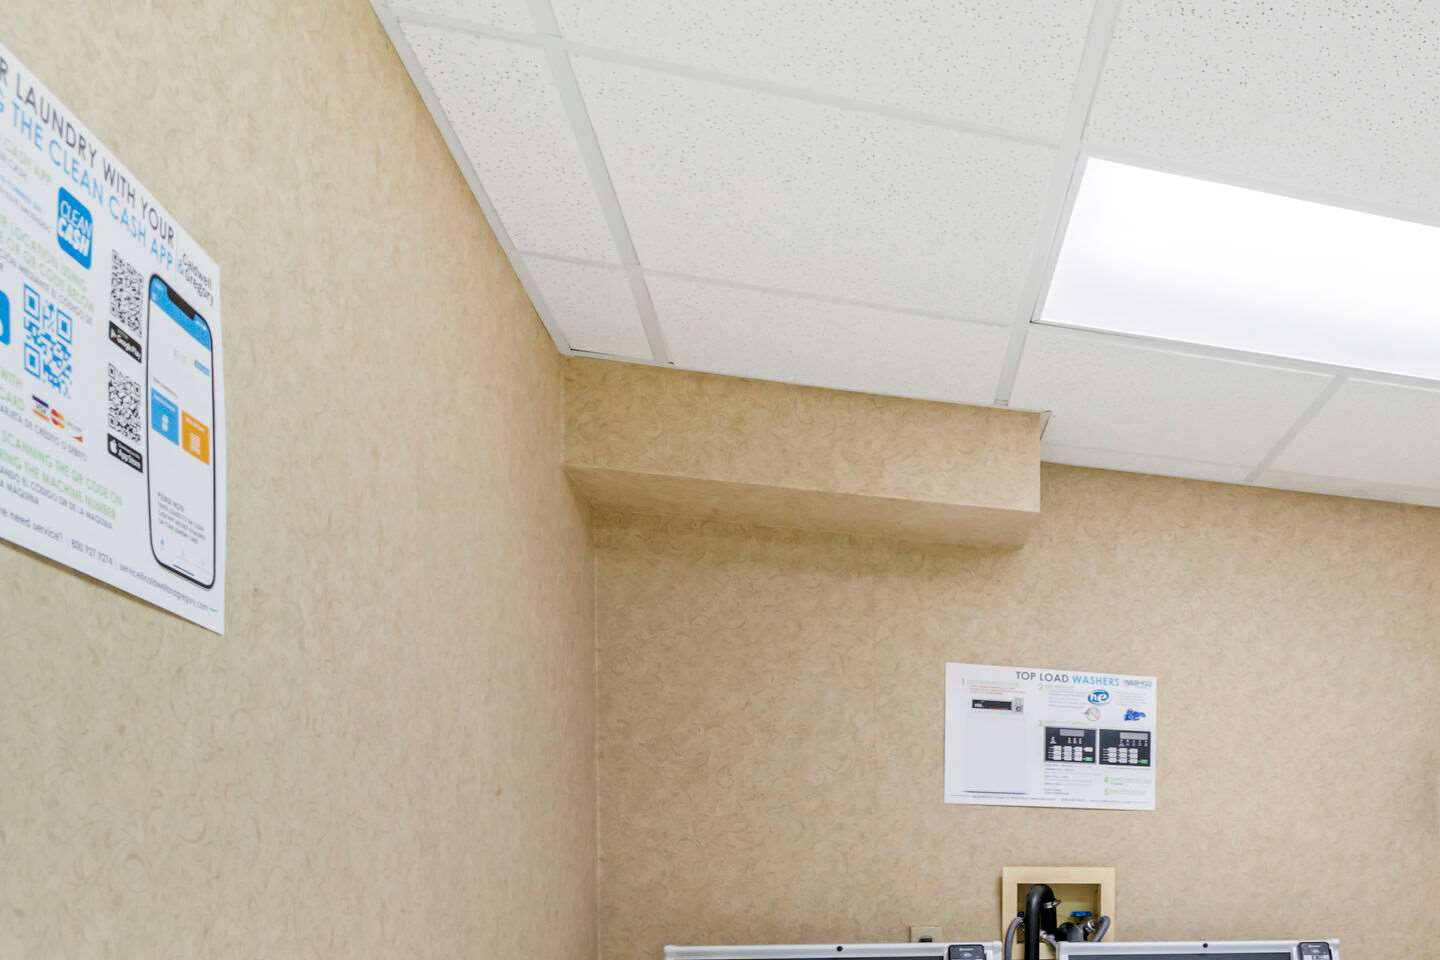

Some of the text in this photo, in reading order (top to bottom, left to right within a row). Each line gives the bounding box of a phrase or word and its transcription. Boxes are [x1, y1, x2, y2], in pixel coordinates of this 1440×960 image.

[16, 71, 98, 169] LAUNDRY
[102, 158, 136, 209] WITH
[141, 195, 174, 249] YOUR
[11, 101, 44, 152] THE
[48, 138, 104, 206] CLEAN
[108, 195, 147, 248] CASH
[150, 238, 174, 271] APP
[56, 216, 91, 258] CASH
[60, 201, 93, 241] CLEAN
[1015, 671, 1037, 681] TOP
[1039, 673, 1069, 684] LOAD
[1071, 674, 1121, 687] WASHERS
